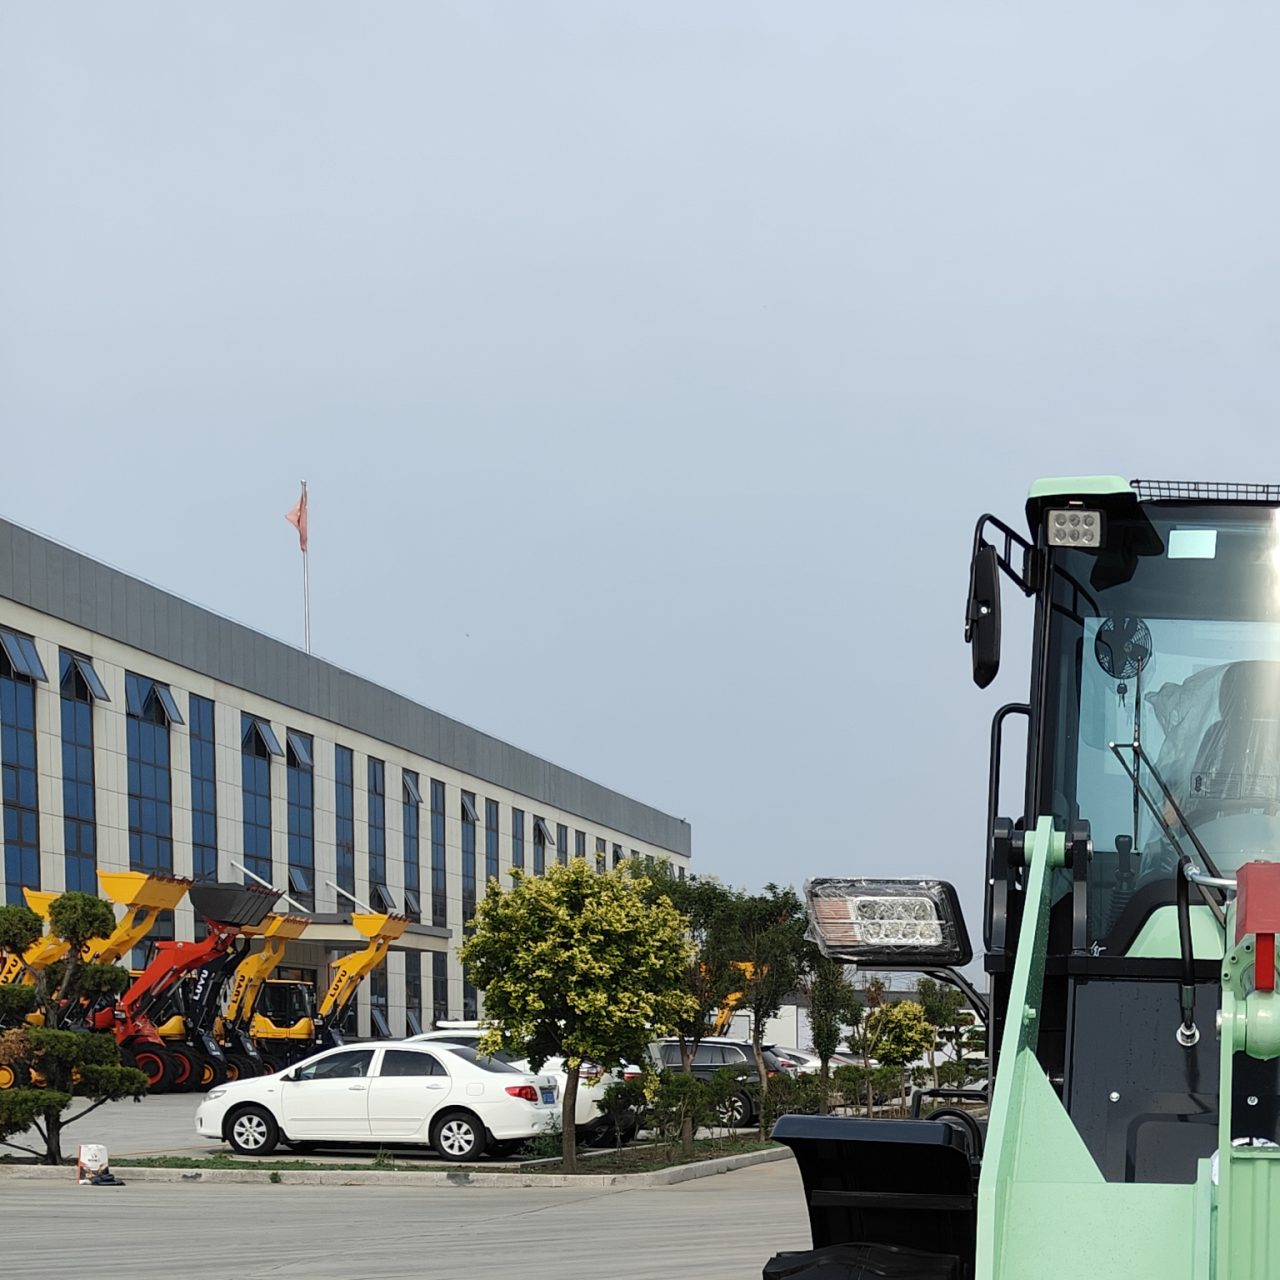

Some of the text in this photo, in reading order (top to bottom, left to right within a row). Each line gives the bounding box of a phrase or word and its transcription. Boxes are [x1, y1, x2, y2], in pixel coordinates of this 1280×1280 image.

[193, 969, 209, 1001] LUYU
[231, 974, 246, 1004] LUYU
[329, 969, 347, 998] LUYU
